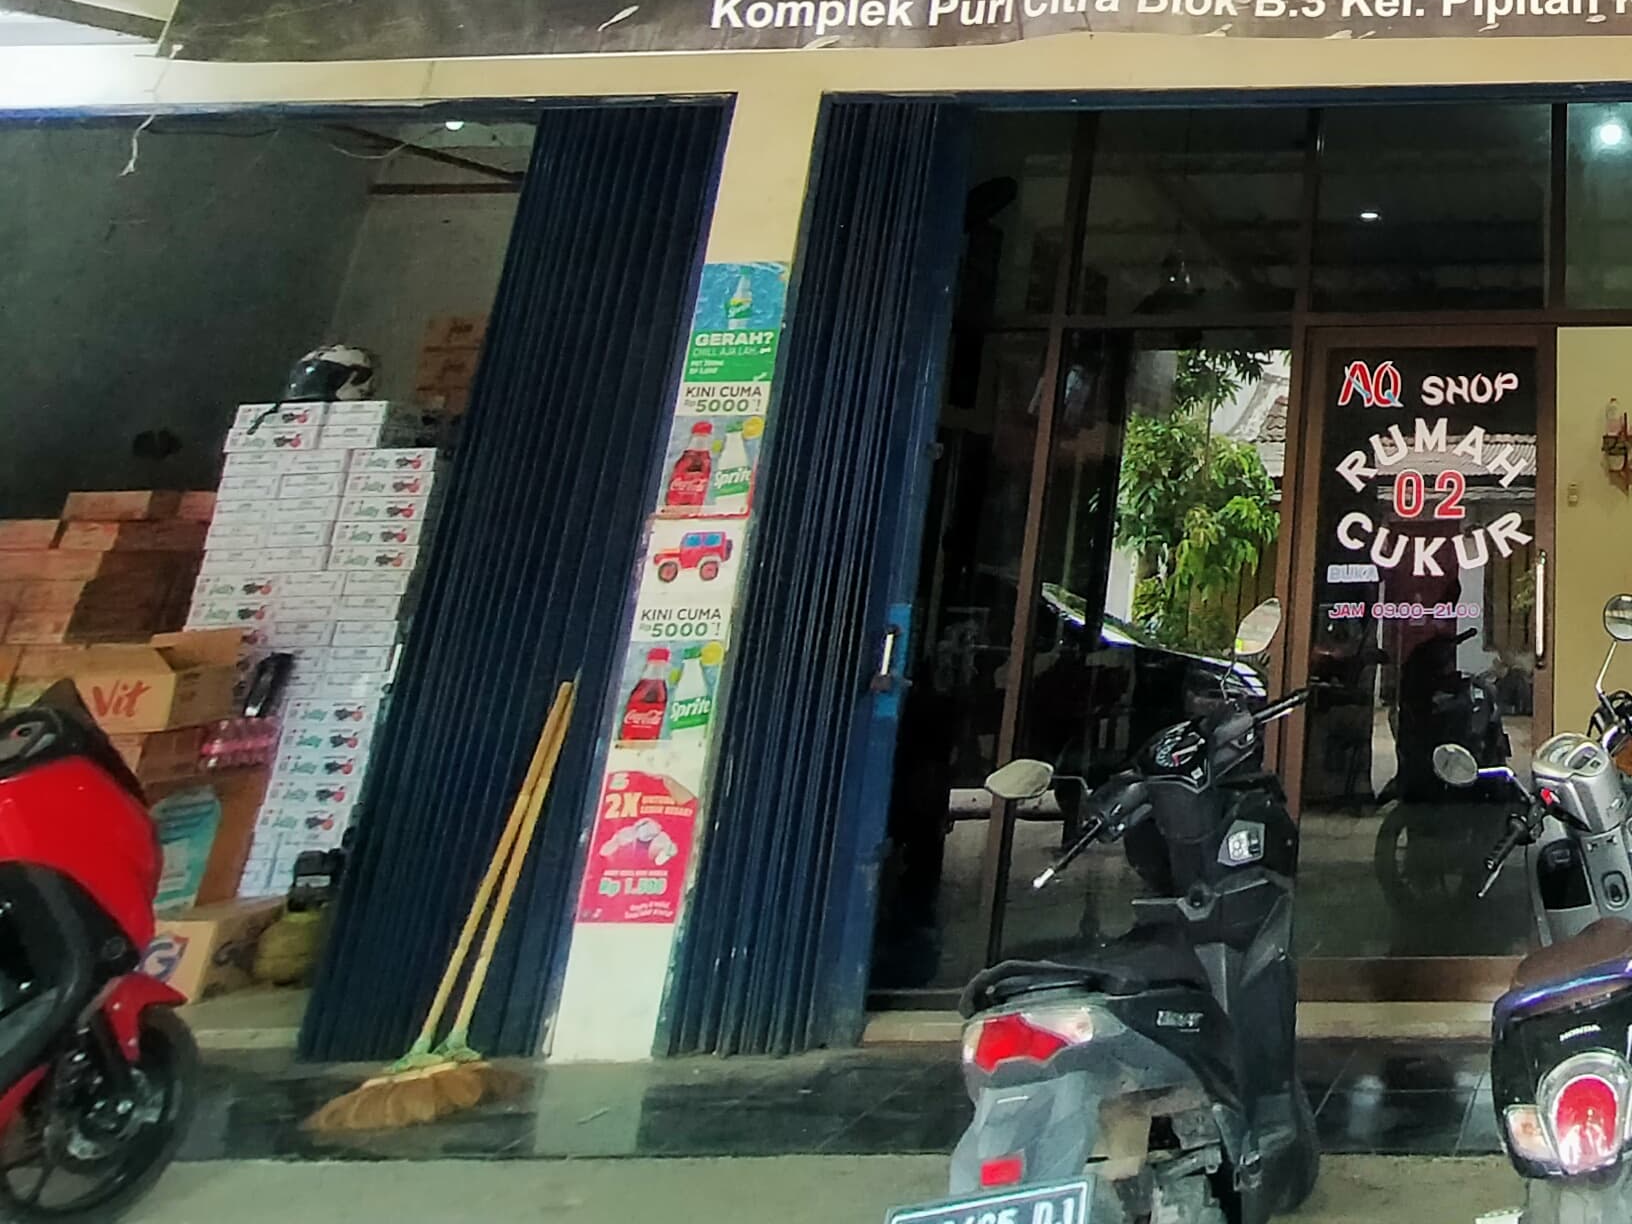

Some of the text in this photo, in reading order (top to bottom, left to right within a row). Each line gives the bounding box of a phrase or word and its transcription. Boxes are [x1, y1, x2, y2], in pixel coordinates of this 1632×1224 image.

[695, 331, 774, 346] GERAH?
[685, 385, 762, 397] KINI CUMA
[1337, 359, 1520, 408] AQ SHOP
[1335, 417, 1529, 493] RUMAH
[1393, 468, 1467, 519] 02
[1336, 511, 1534, 577] CUKUR
[640, 608, 722, 621] KINI CUMA
[1328, 602, 1365, 619] JAM
[92, 679, 151, 717] Vit
